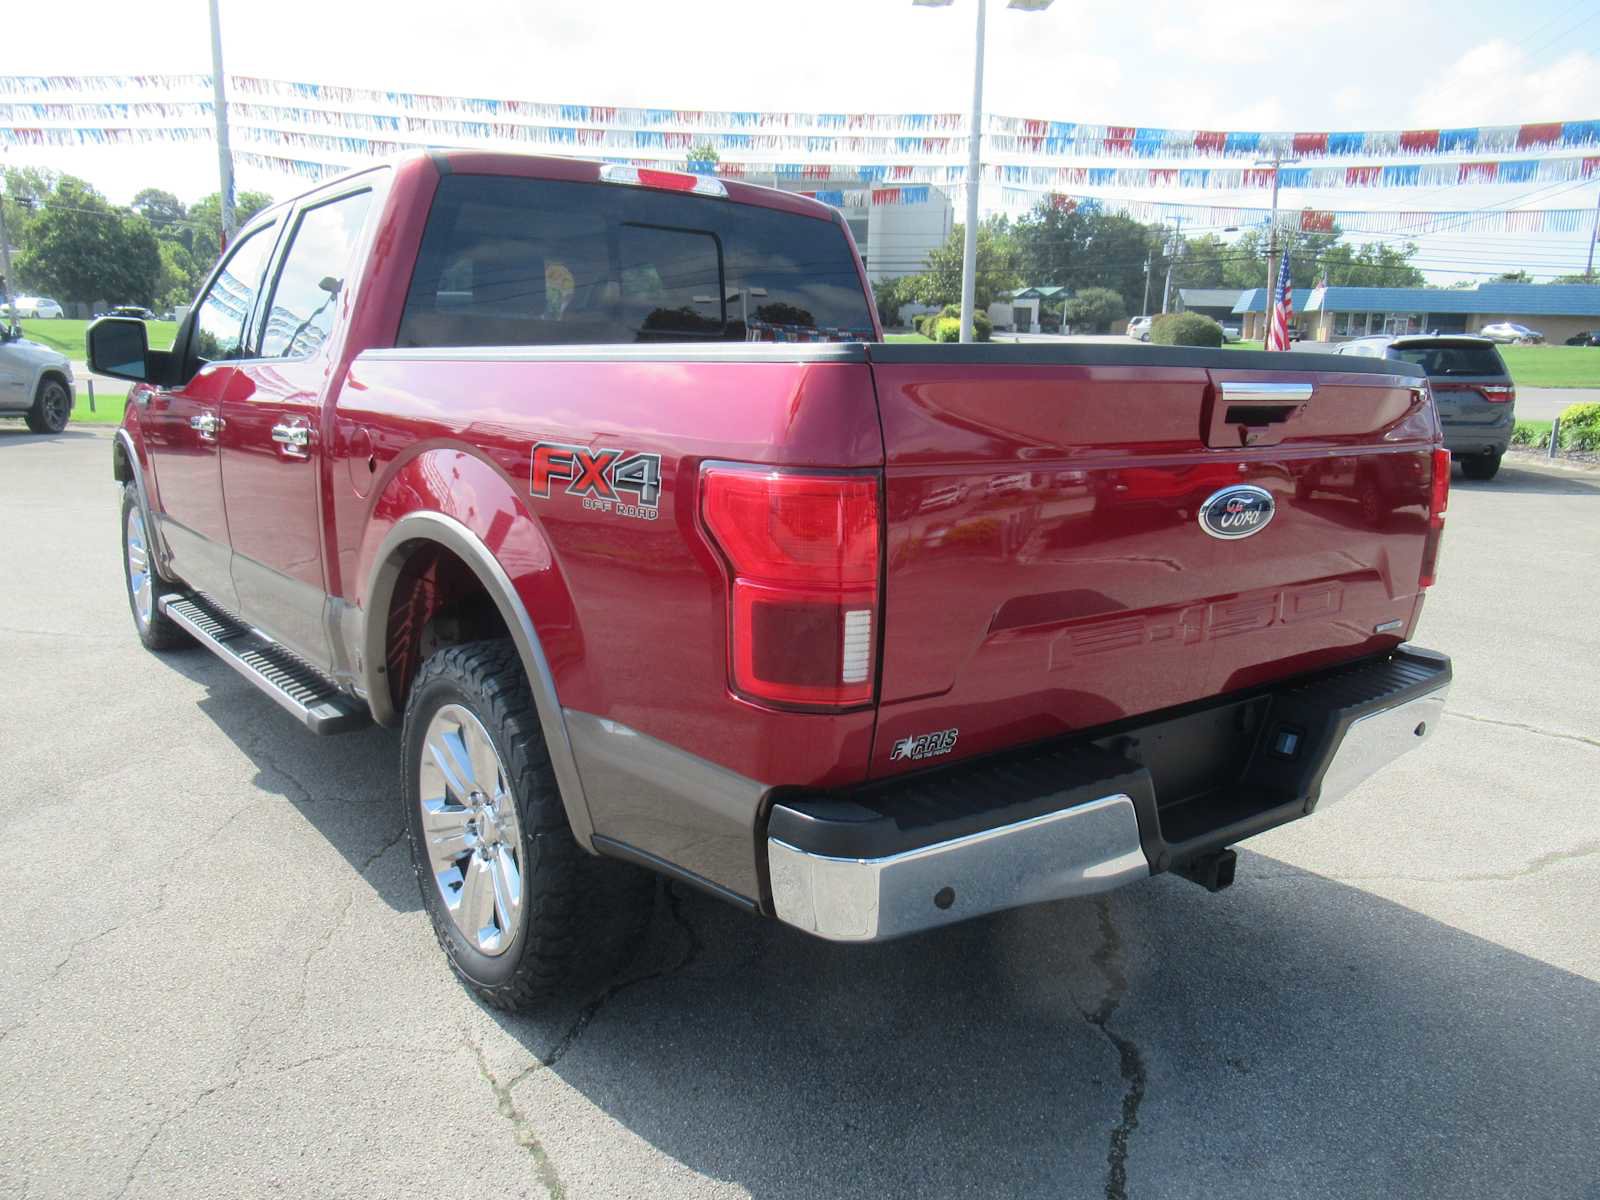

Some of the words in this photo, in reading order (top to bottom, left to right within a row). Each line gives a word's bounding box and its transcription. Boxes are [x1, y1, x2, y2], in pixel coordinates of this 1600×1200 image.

[530, 441, 662, 508] FX4
[582, 497, 613, 512] OFF
[616, 502, 659, 520] ROAD
[1221, 497, 1262, 528] Ford
[1048, 579, 1345, 672] F-150
